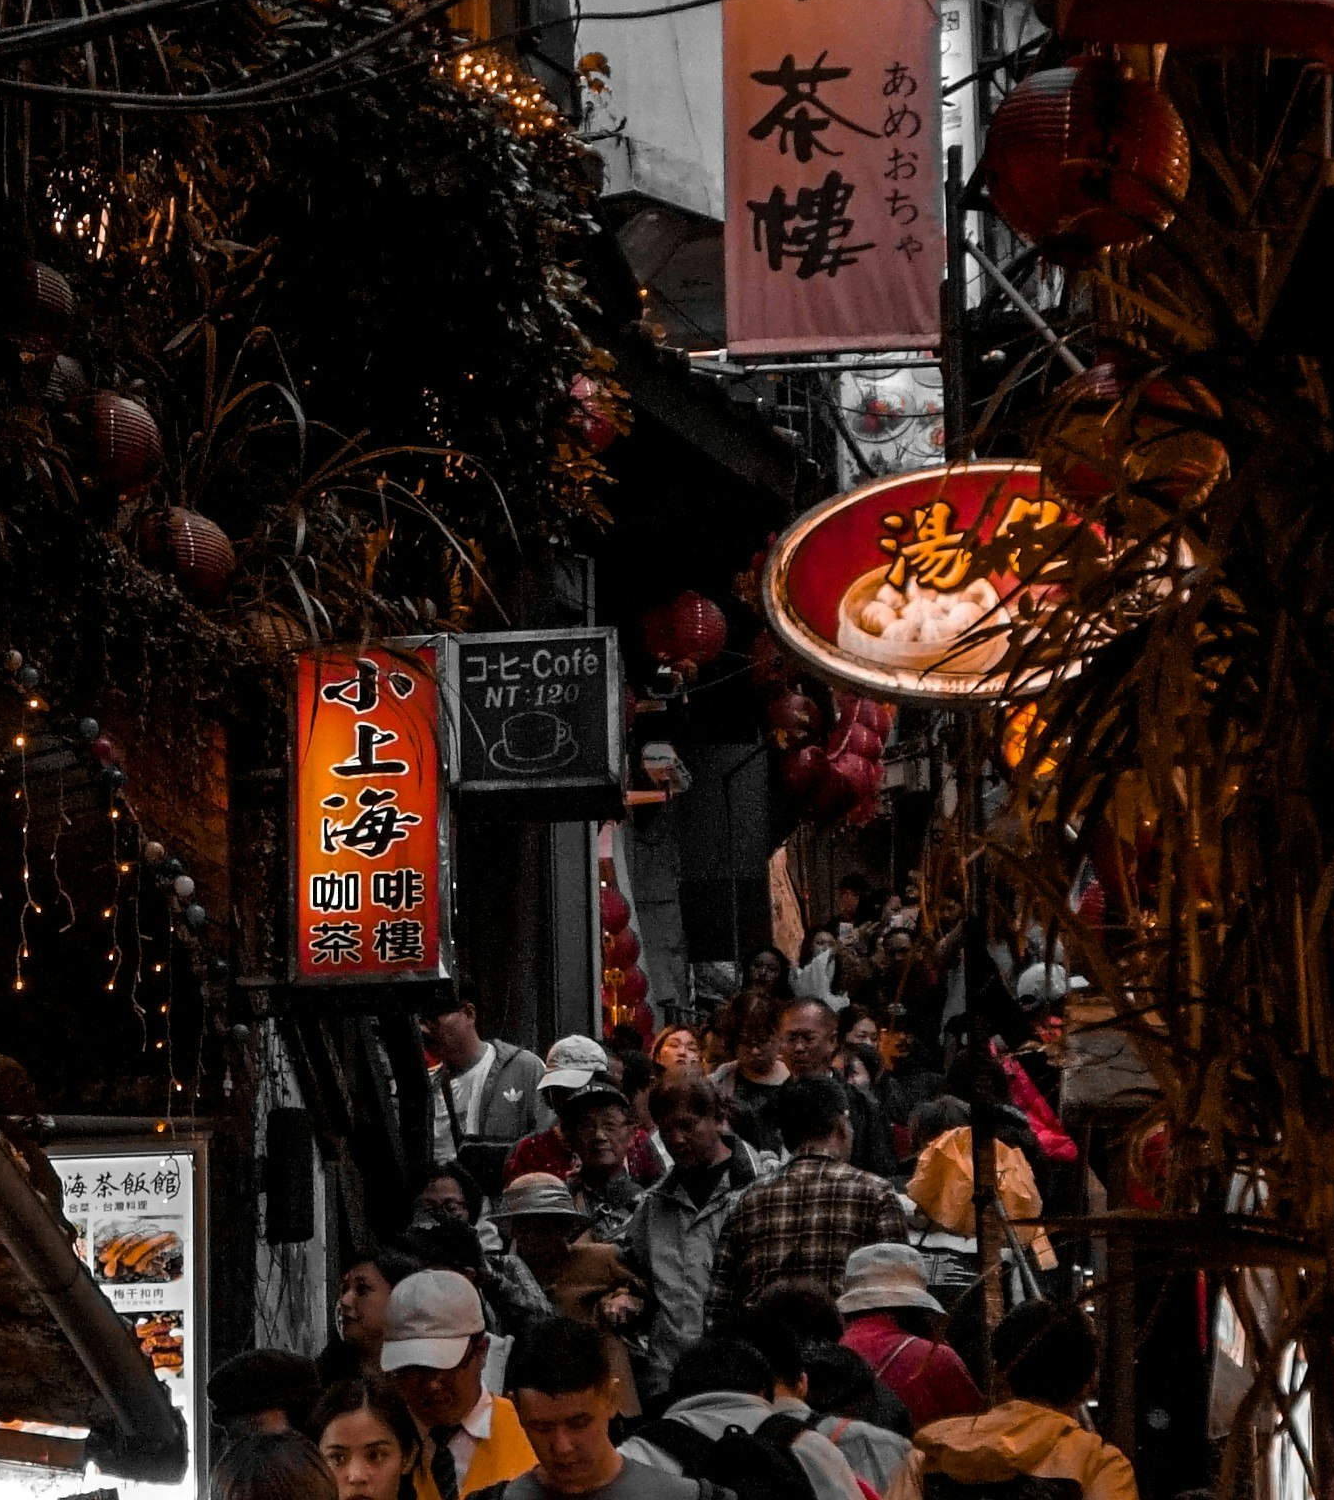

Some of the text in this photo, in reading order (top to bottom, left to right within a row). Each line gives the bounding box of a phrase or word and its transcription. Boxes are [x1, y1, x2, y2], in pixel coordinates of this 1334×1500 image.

[322, 658, 423, 859] 小上海
[310, 868, 425, 914] 咖啡
[311, 920, 424, 965] 茶樓
